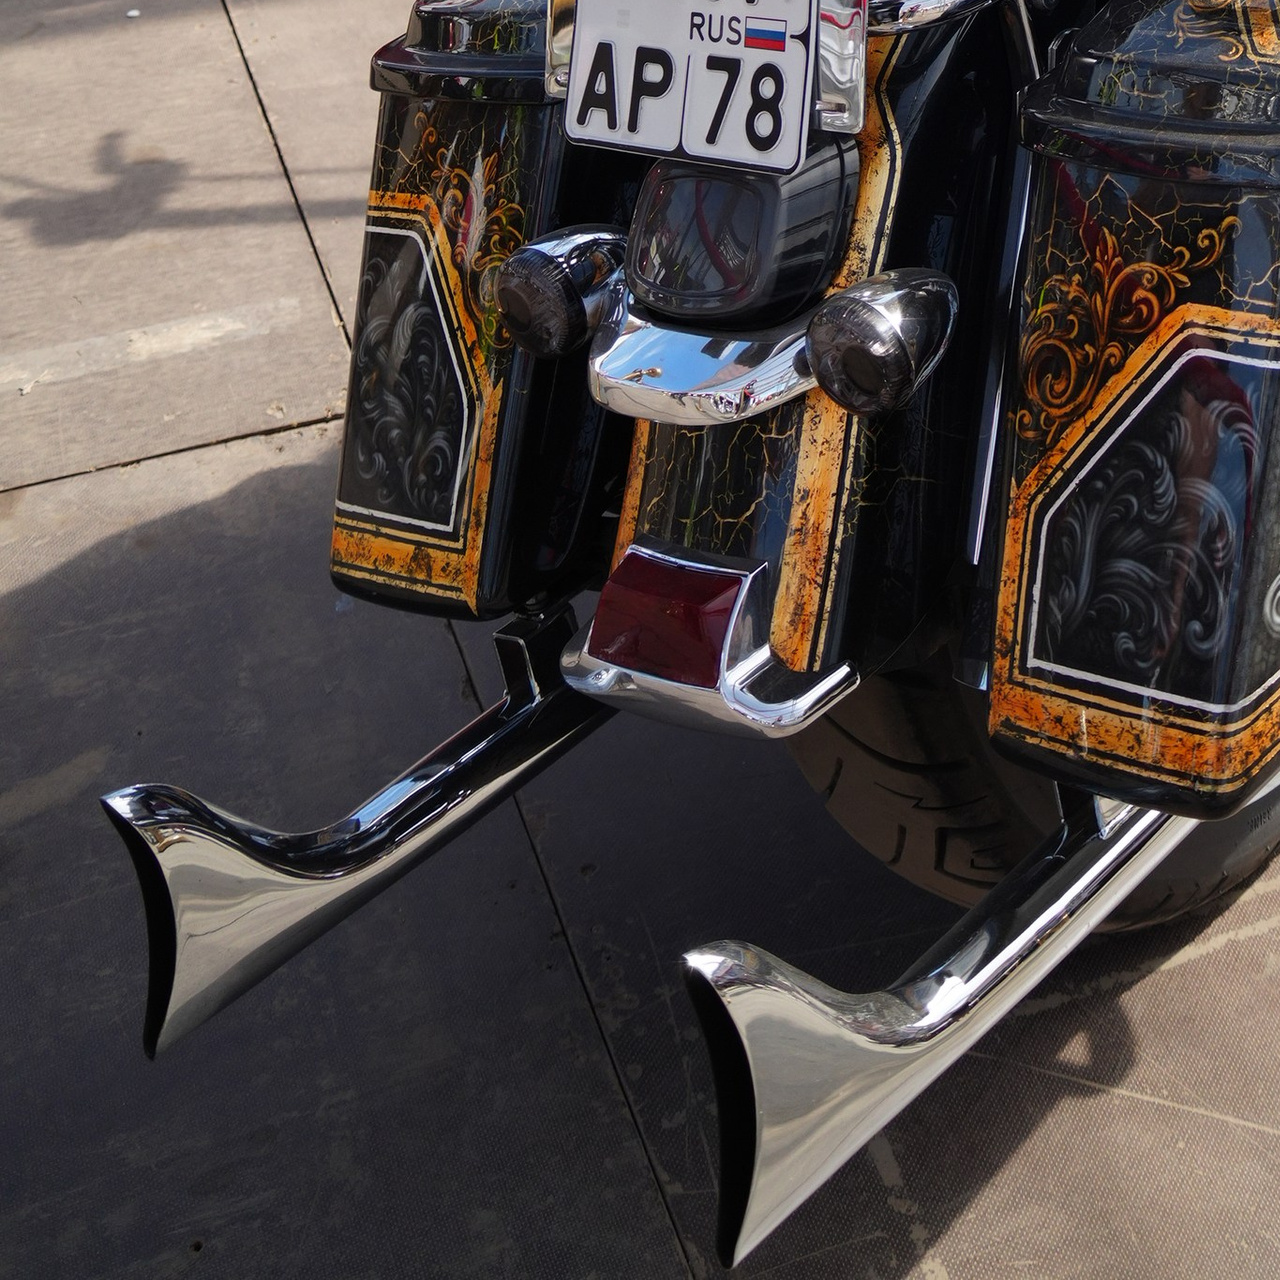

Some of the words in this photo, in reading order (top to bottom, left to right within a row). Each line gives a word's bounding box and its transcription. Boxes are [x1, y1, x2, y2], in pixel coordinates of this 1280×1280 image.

[690, 11, 742, 46] RUS
[576, 41, 676, 133] AP
[705, 54, 785, 153] 78
